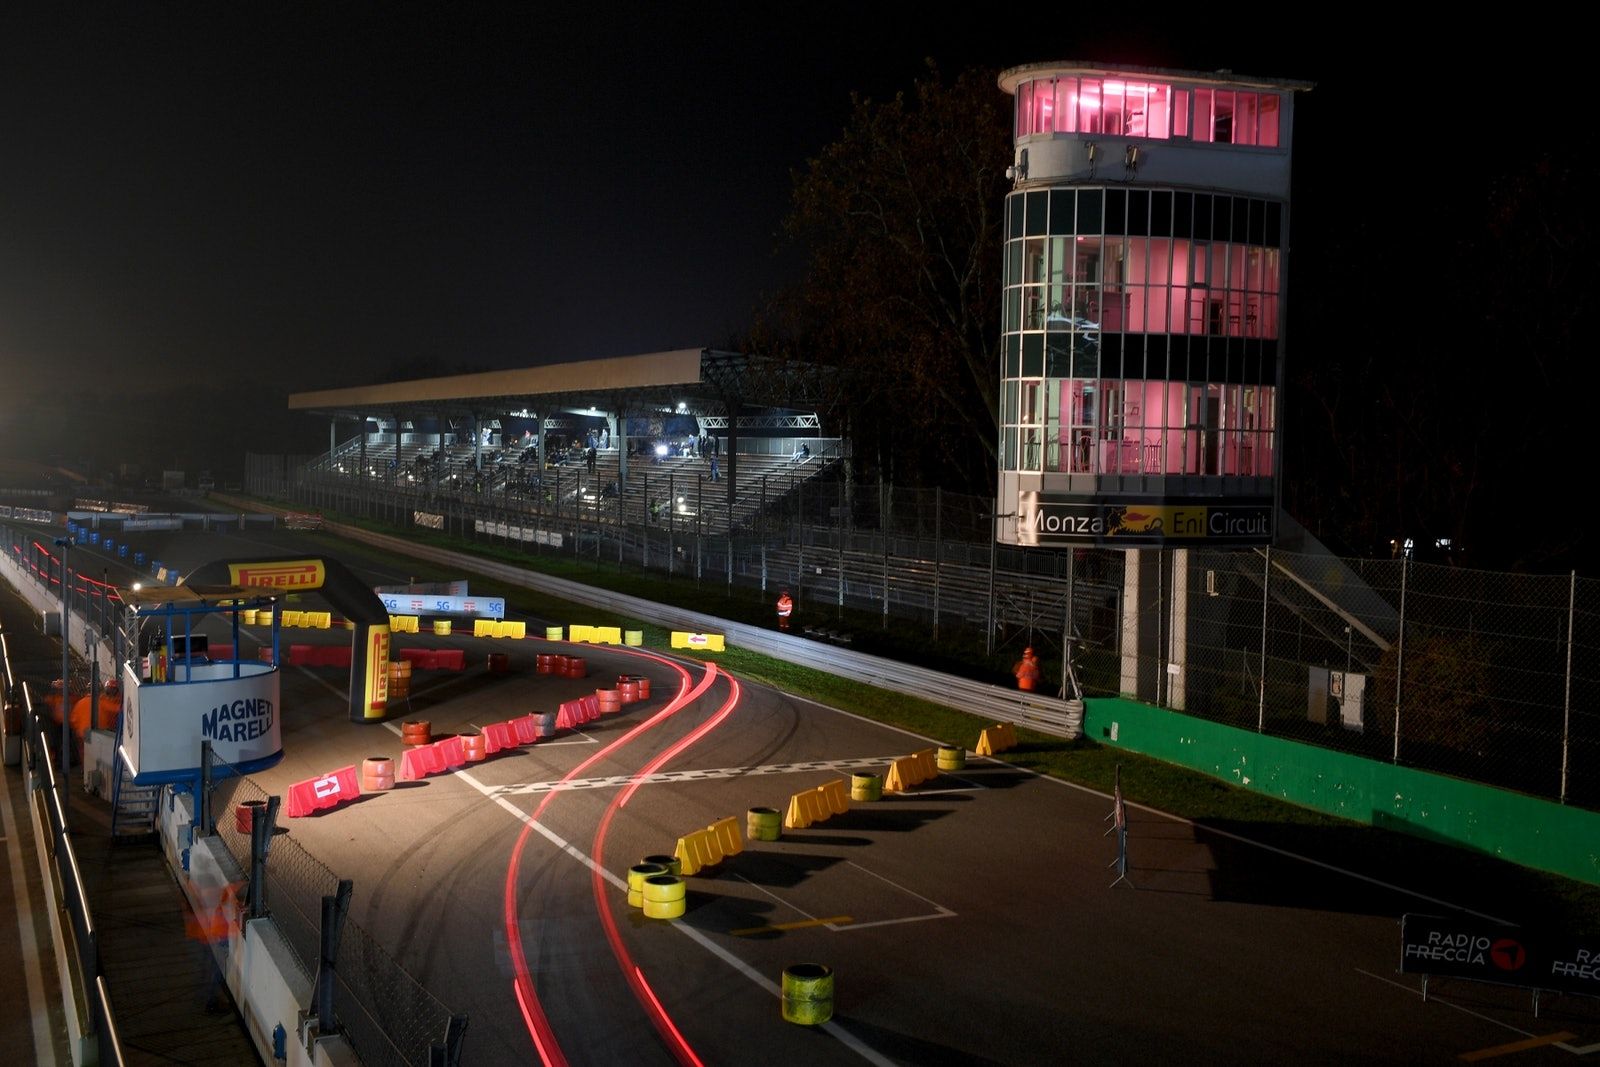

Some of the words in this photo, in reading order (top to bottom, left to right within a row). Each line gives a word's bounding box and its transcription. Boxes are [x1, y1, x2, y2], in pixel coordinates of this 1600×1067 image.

[1027, 509, 1103, 533] Monza
[1173, 512, 1203, 534] Eni
[1210, 512, 1267, 534] Circuit
[239, 565, 317, 588] PIRELLI
[384, 599, 397, 609] 5G
[436, 601, 450, 611] 5G
[489, 603, 501, 613] 5G
[371, 633, 389, 709] PIRELLI
[1405, 943, 1486, 966] FRECCIA
[1428, 931, 1490, 957] RADIO
